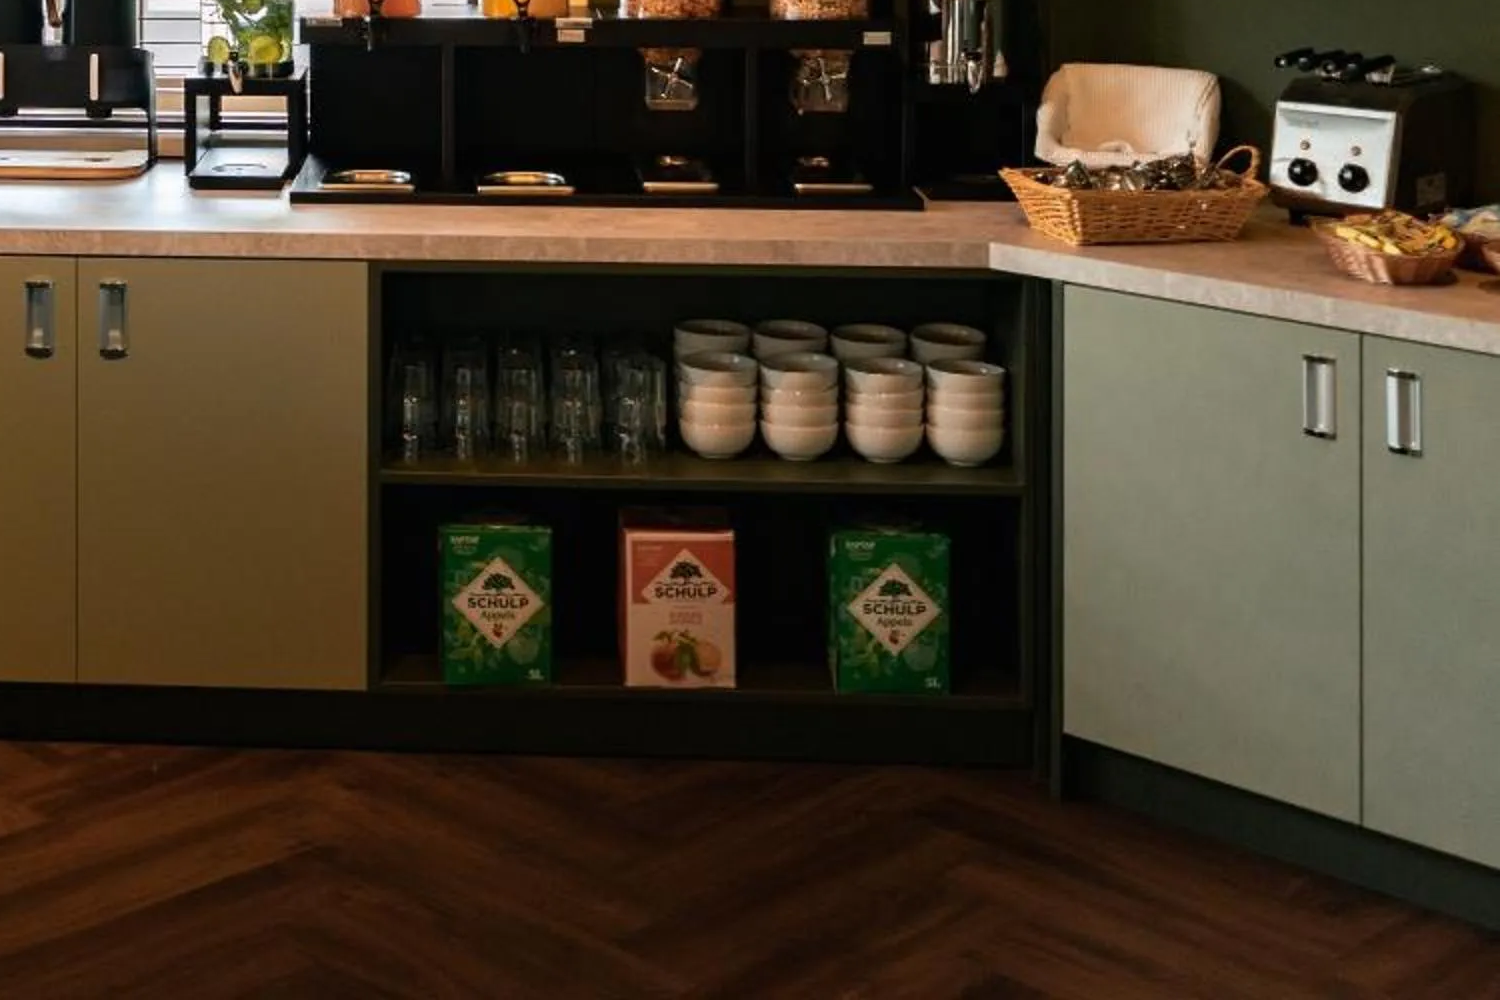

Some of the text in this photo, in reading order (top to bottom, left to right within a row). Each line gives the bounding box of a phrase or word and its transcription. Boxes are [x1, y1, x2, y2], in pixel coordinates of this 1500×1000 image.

[655, 586, 717, 599] SCHULP
[467, 597, 530, 609] SCHULP
[863, 603, 927, 615] SCHULP
